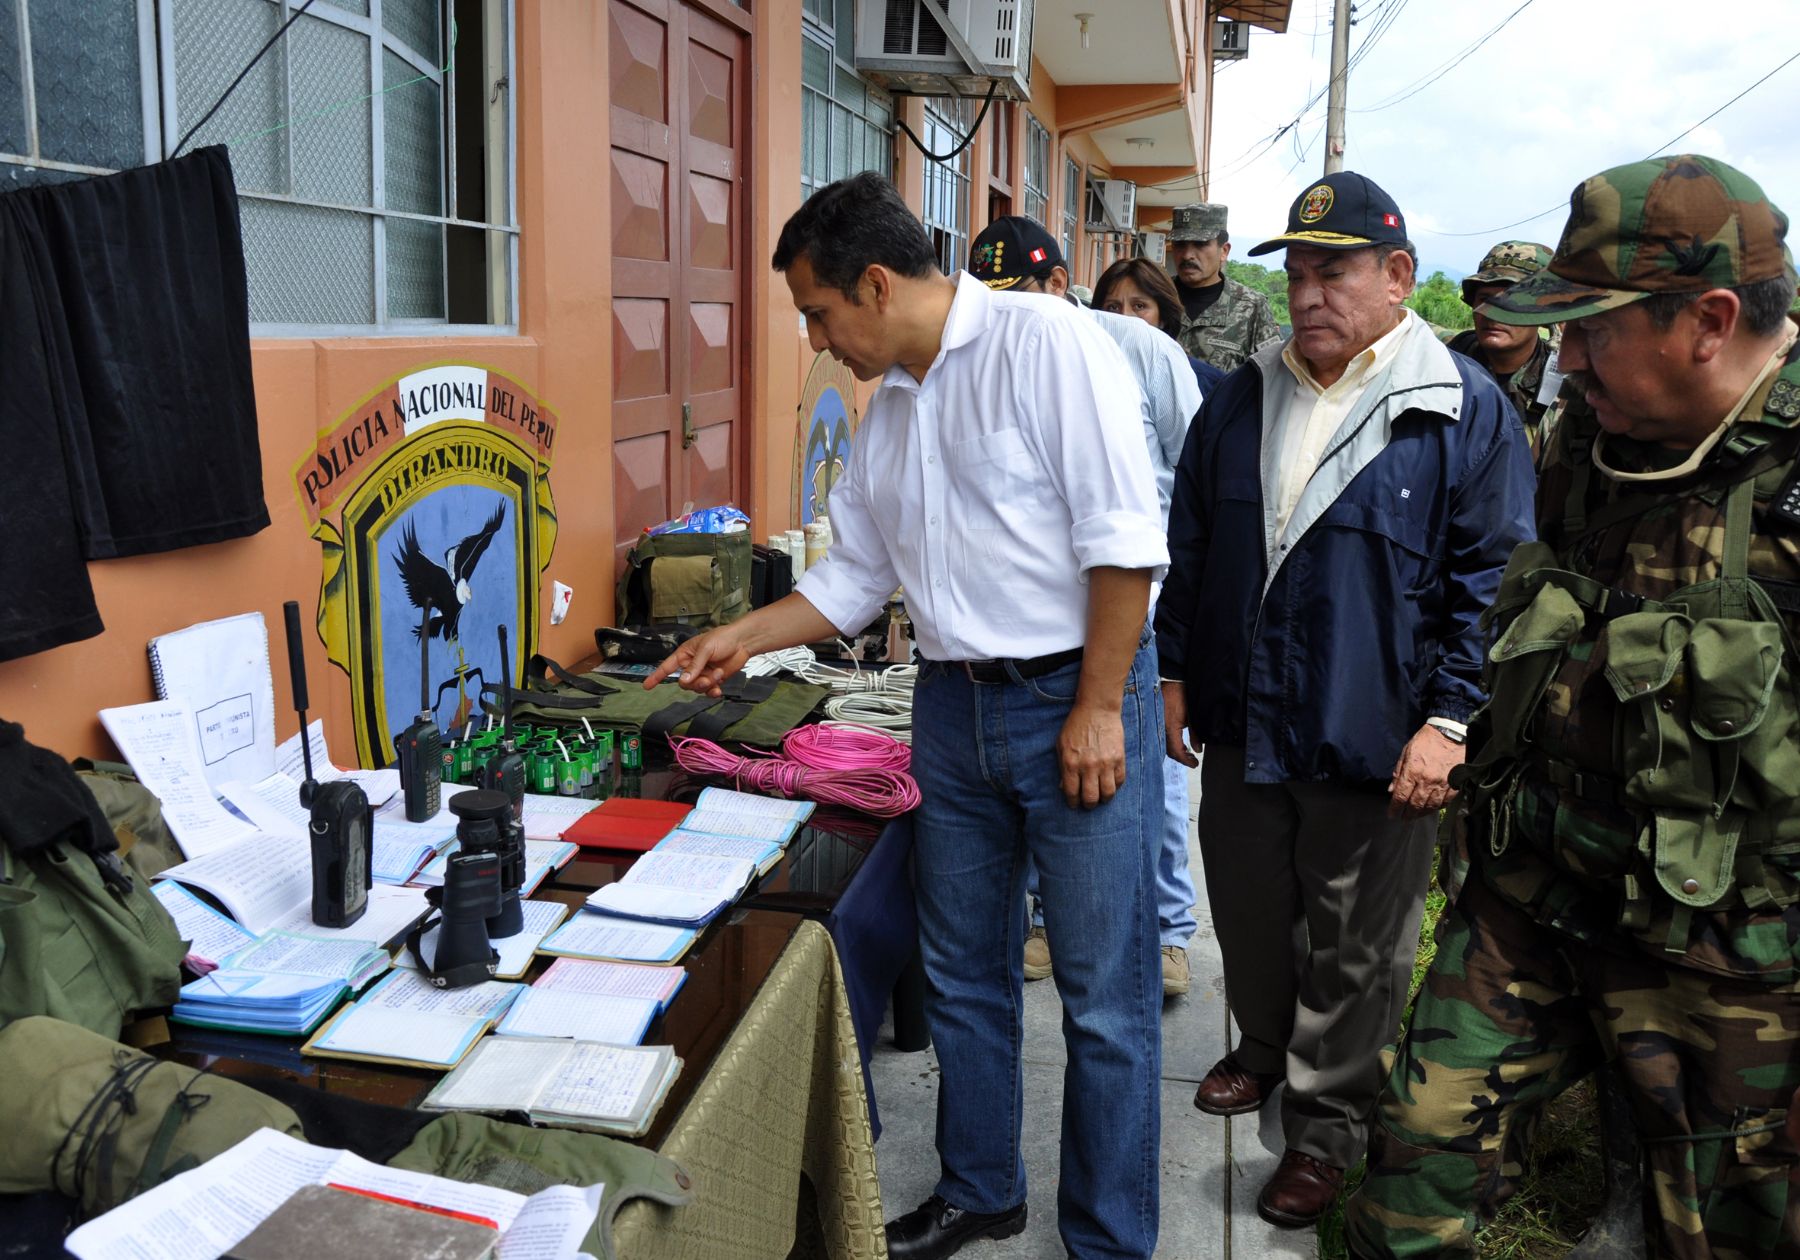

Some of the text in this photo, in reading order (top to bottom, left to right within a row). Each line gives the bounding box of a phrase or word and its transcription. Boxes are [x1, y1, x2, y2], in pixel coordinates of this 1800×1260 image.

[303, 381, 554, 505] POLICIA NACIONAL DEL PERU
[377, 440, 509, 517] DIRANDRO
